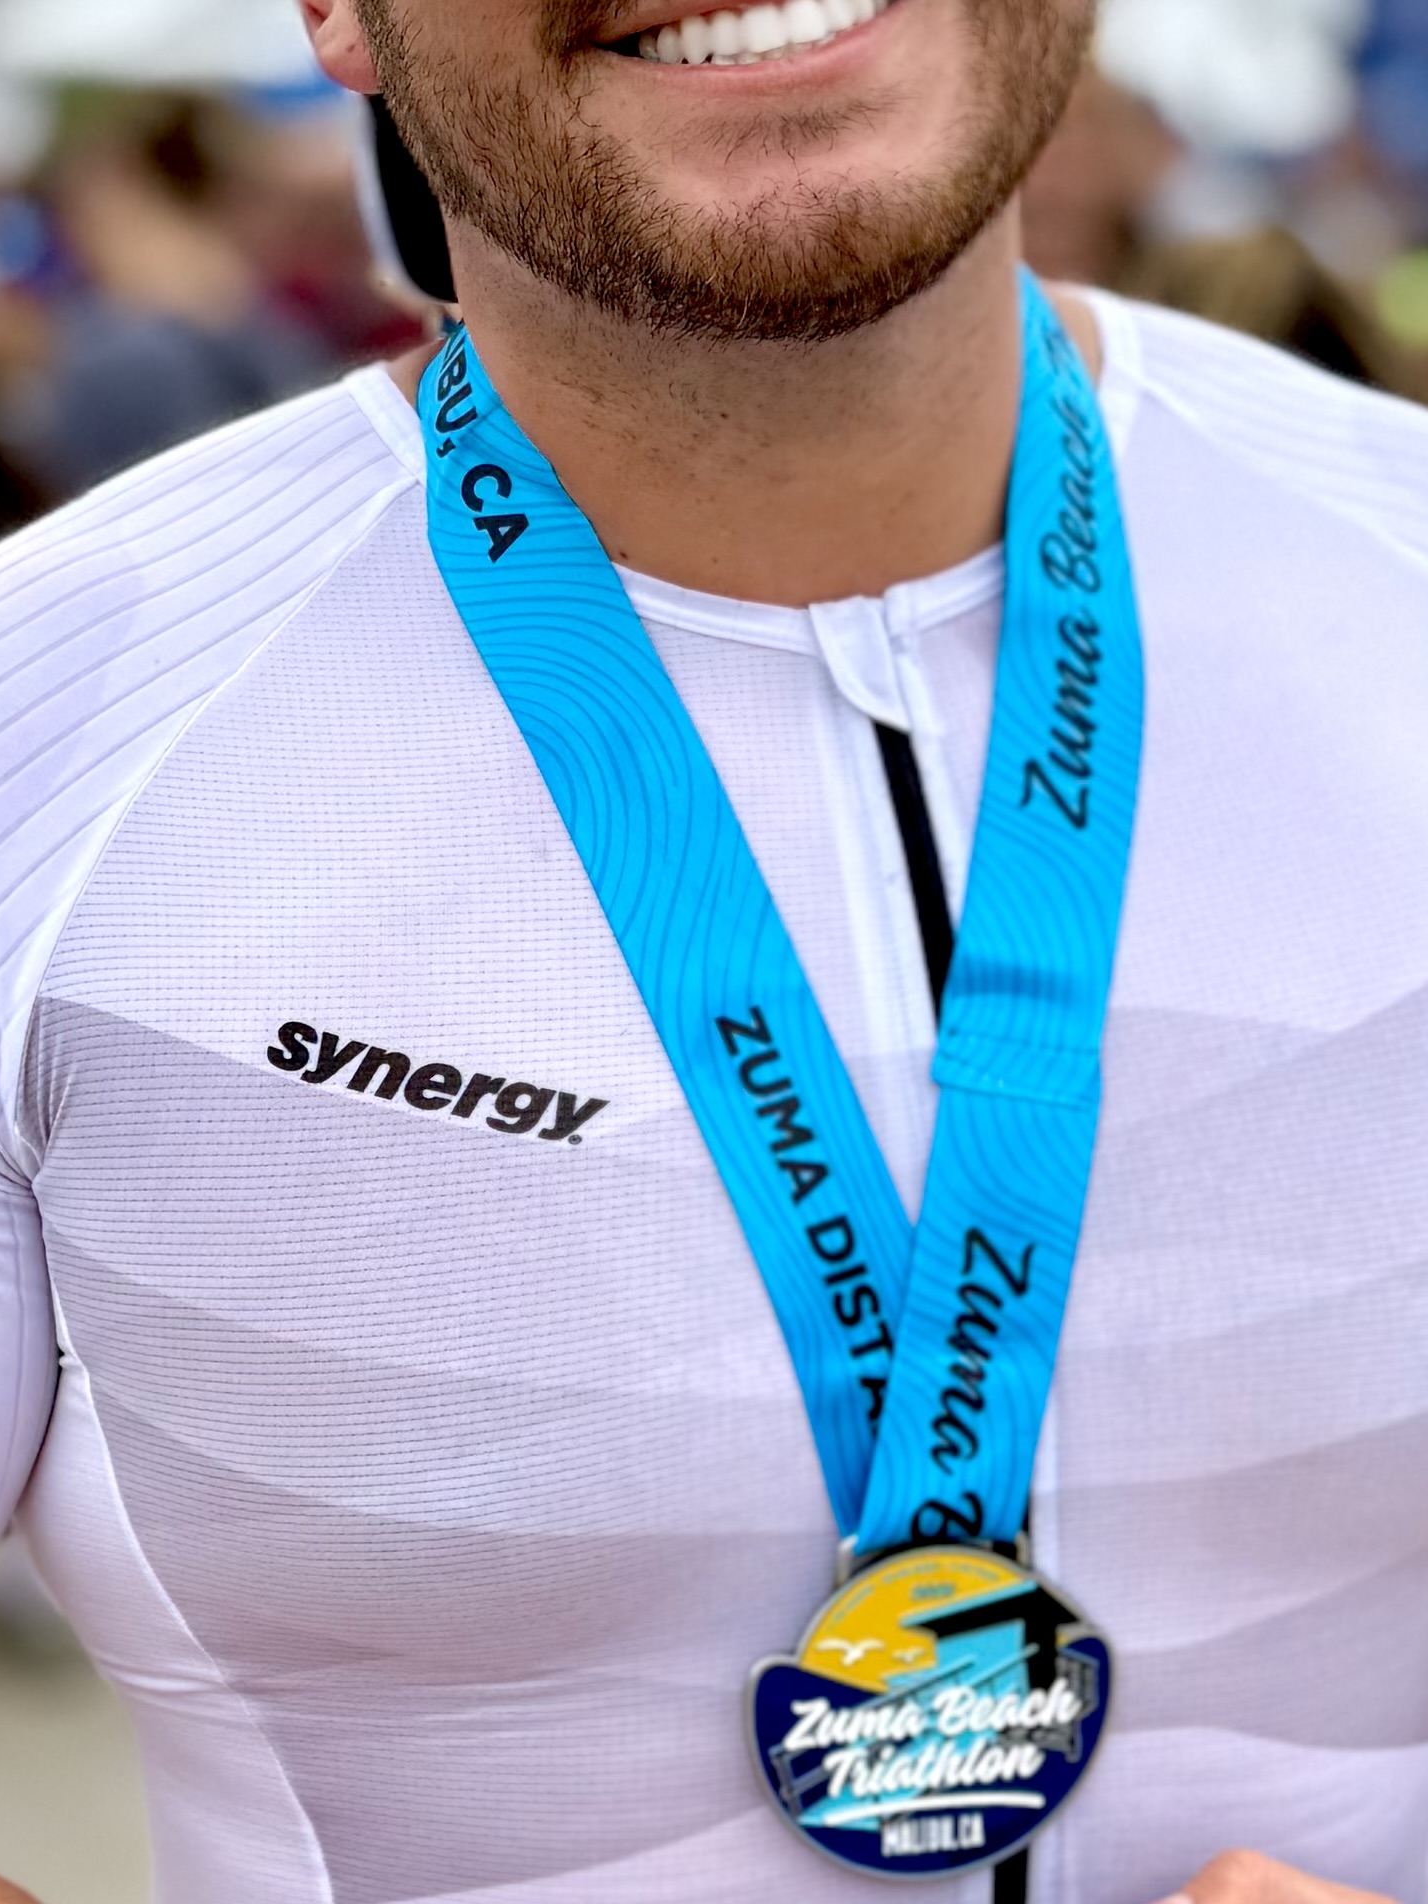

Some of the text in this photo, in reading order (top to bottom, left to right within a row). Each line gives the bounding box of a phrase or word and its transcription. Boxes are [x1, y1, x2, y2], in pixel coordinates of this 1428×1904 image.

[461, 463, 530, 563] CA
[1039, 396, 1101, 593] Beach
[1020, 607, 1102, 830] Zuma
[715, 1007, 830, 1205] ZUMA
[931, 1227, 1037, 1476] Zuma
[783, 1676, 1082, 1752] Zuma Beach
[824, 1738, 1045, 1797] Triathlon
